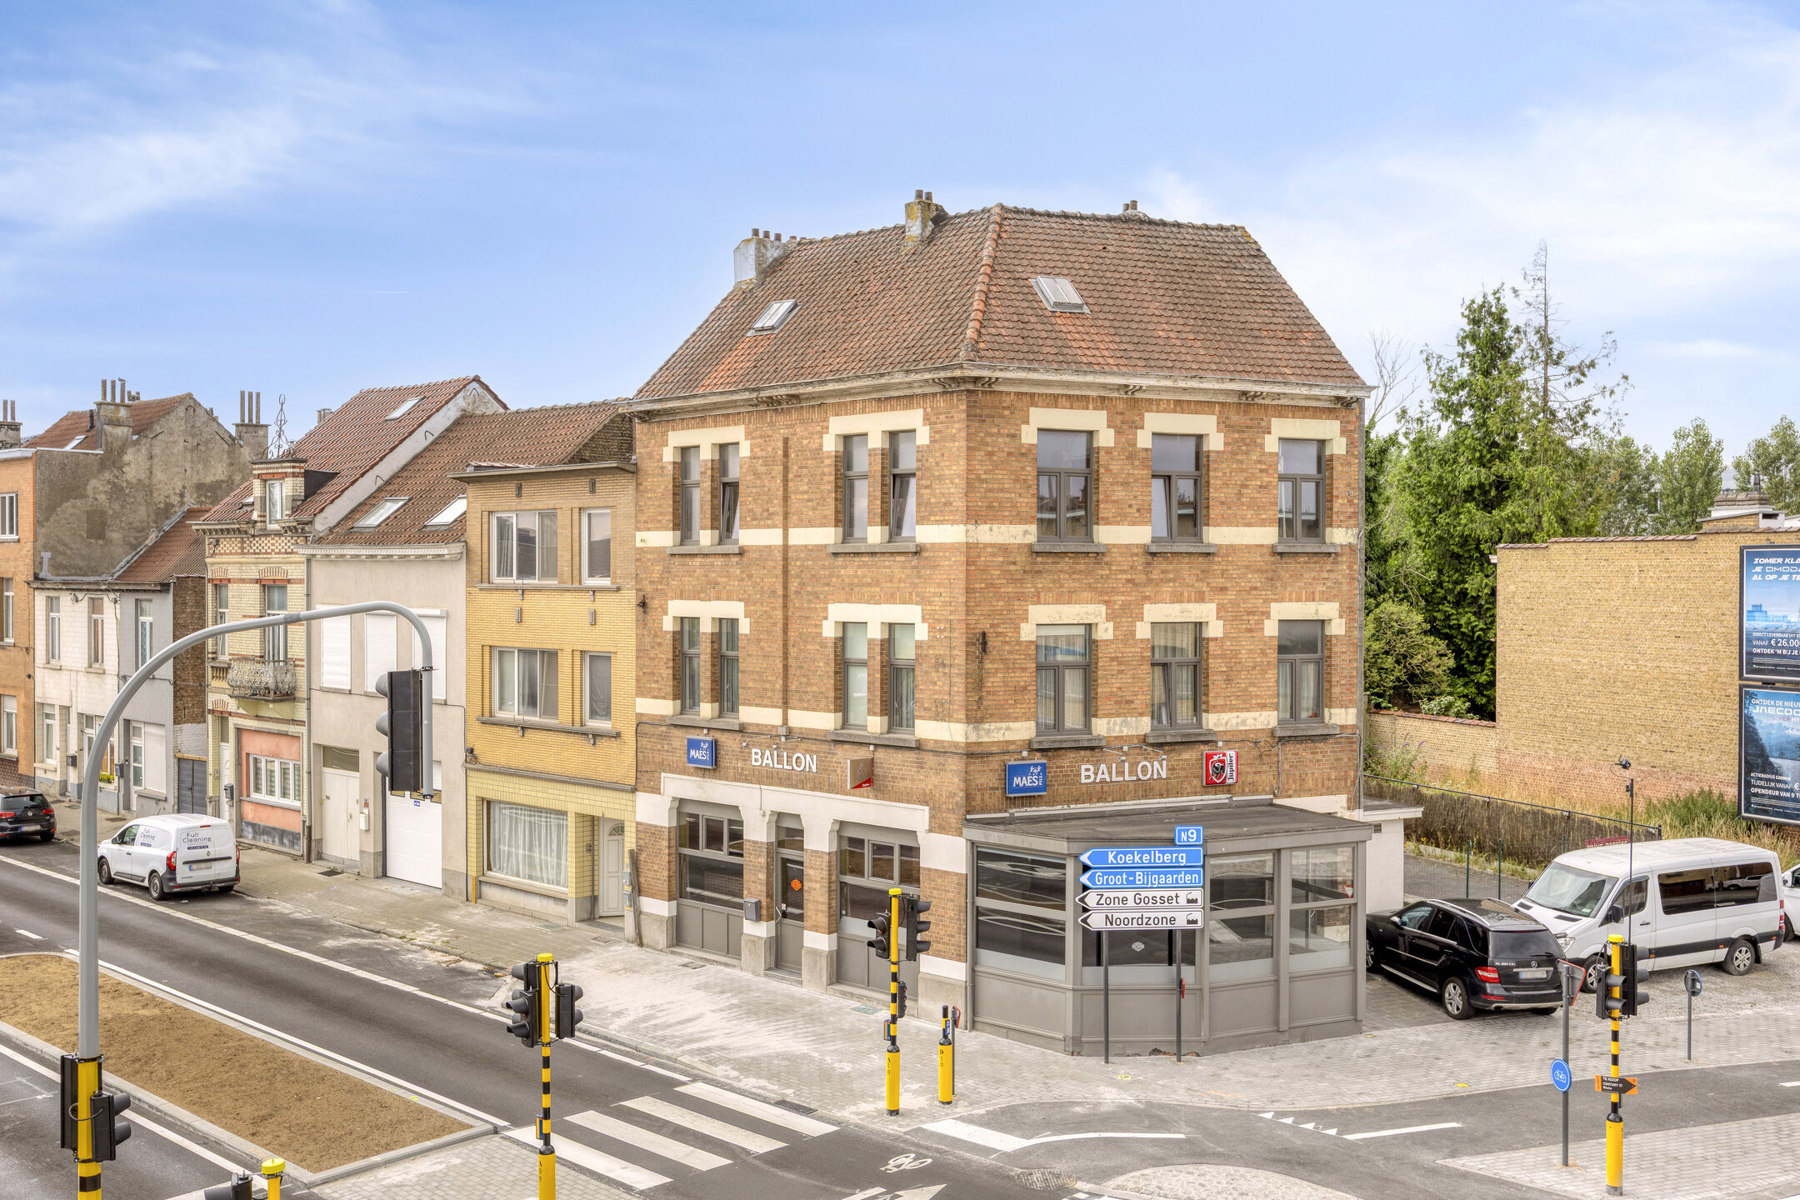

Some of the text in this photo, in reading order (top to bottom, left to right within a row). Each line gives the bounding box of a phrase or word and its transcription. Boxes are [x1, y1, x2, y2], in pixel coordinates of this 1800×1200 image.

[1751, 698, 1775, 706] ONTDEK
[689, 748, 707, 760] MAES
[751, 748, 817, 773] BALLON
[1080, 760, 1167, 784] BALLON
[1013, 775, 1038, 787] MAES
[1750, 779, 1775, 788] TIJDELIJK
[1750, 787, 1779, 797] OPENDEUR
[182, 836, 212, 844] Cleaning
[1181, 829, 1197, 842] N9
[1108, 851, 1187, 866] Koekelberg
[1095, 871, 1199, 887] Groot-Bijgaarden
[1096, 892, 1180, 906] Zone Gosset
[1105, 914, 1177, 927] Noordzone
